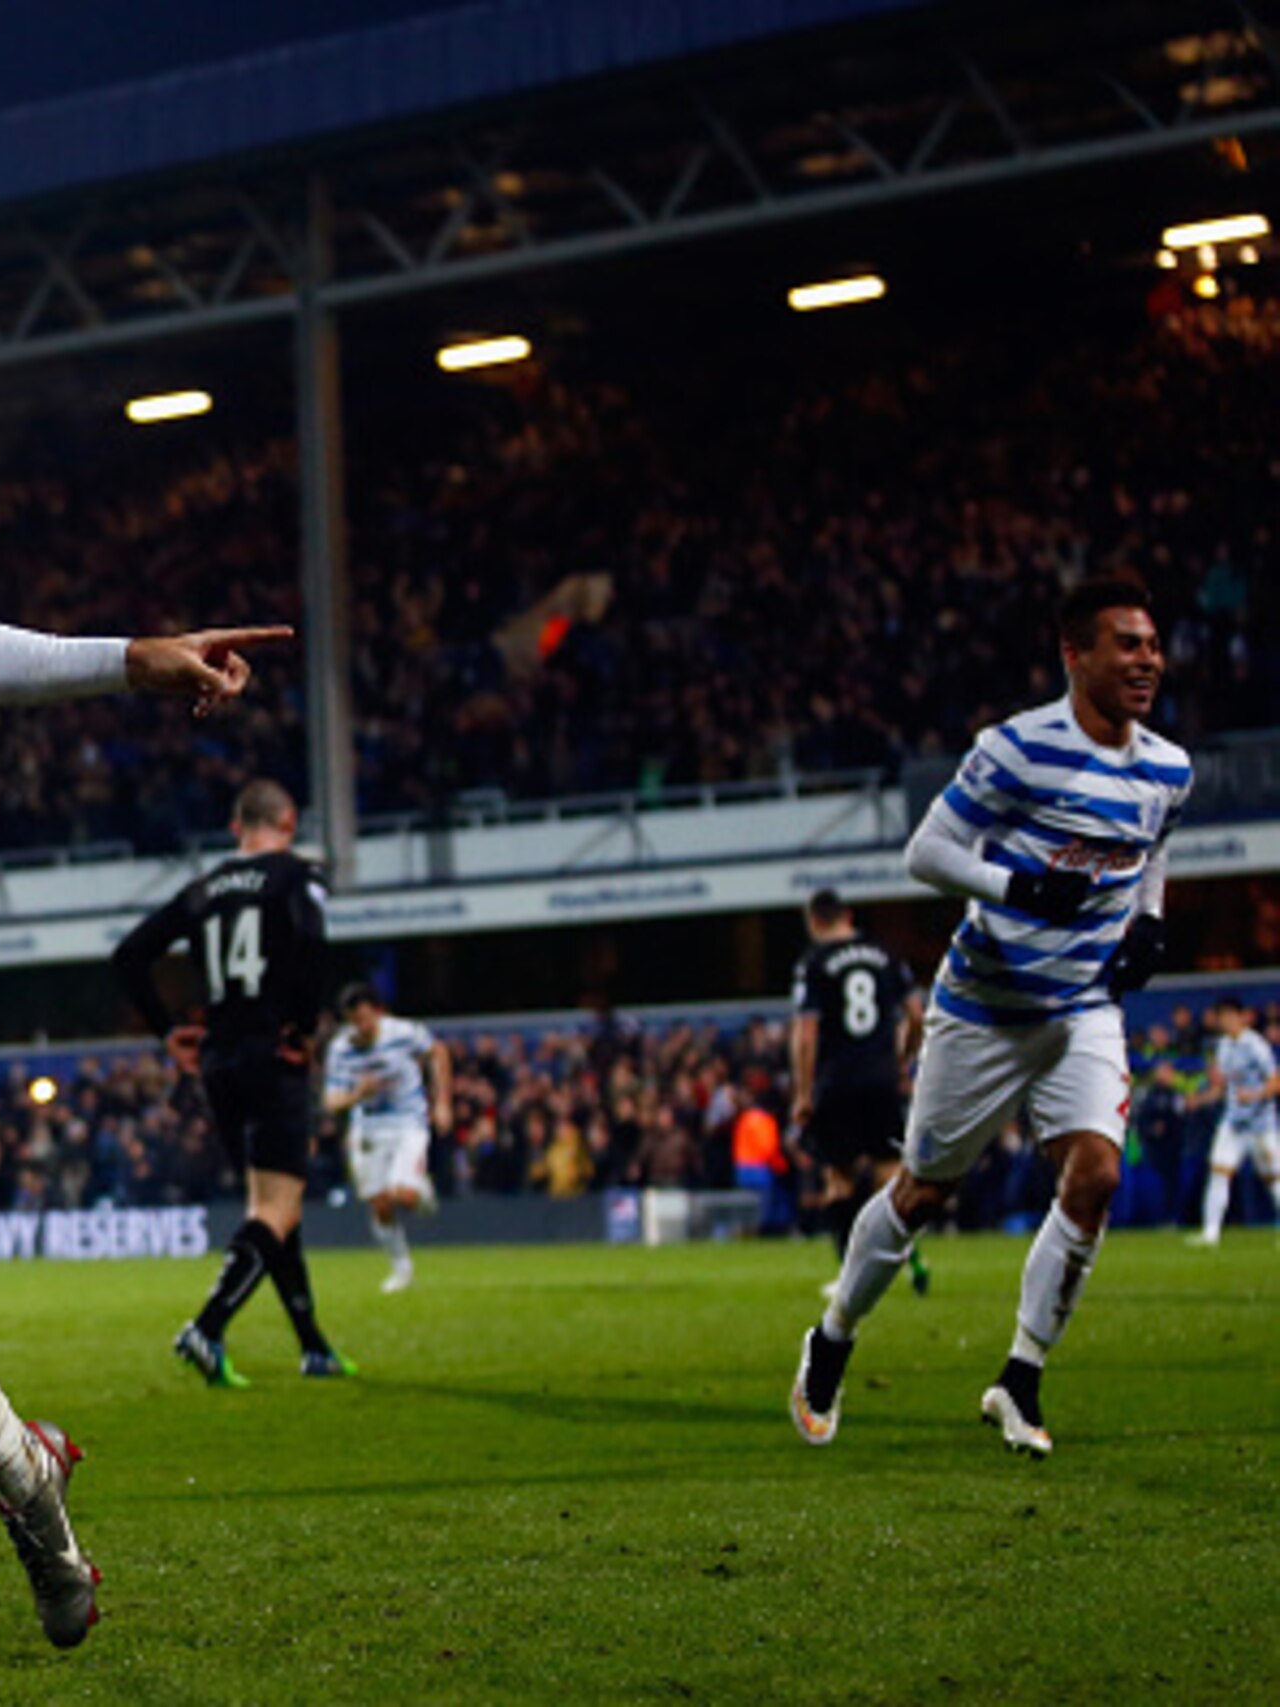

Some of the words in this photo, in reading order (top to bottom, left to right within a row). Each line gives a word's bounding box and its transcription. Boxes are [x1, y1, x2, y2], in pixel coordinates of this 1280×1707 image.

[206, 907, 266, 1001] 14
[845, 970, 877, 1034] 8
[44, 1207, 208, 1257] RESERVES
